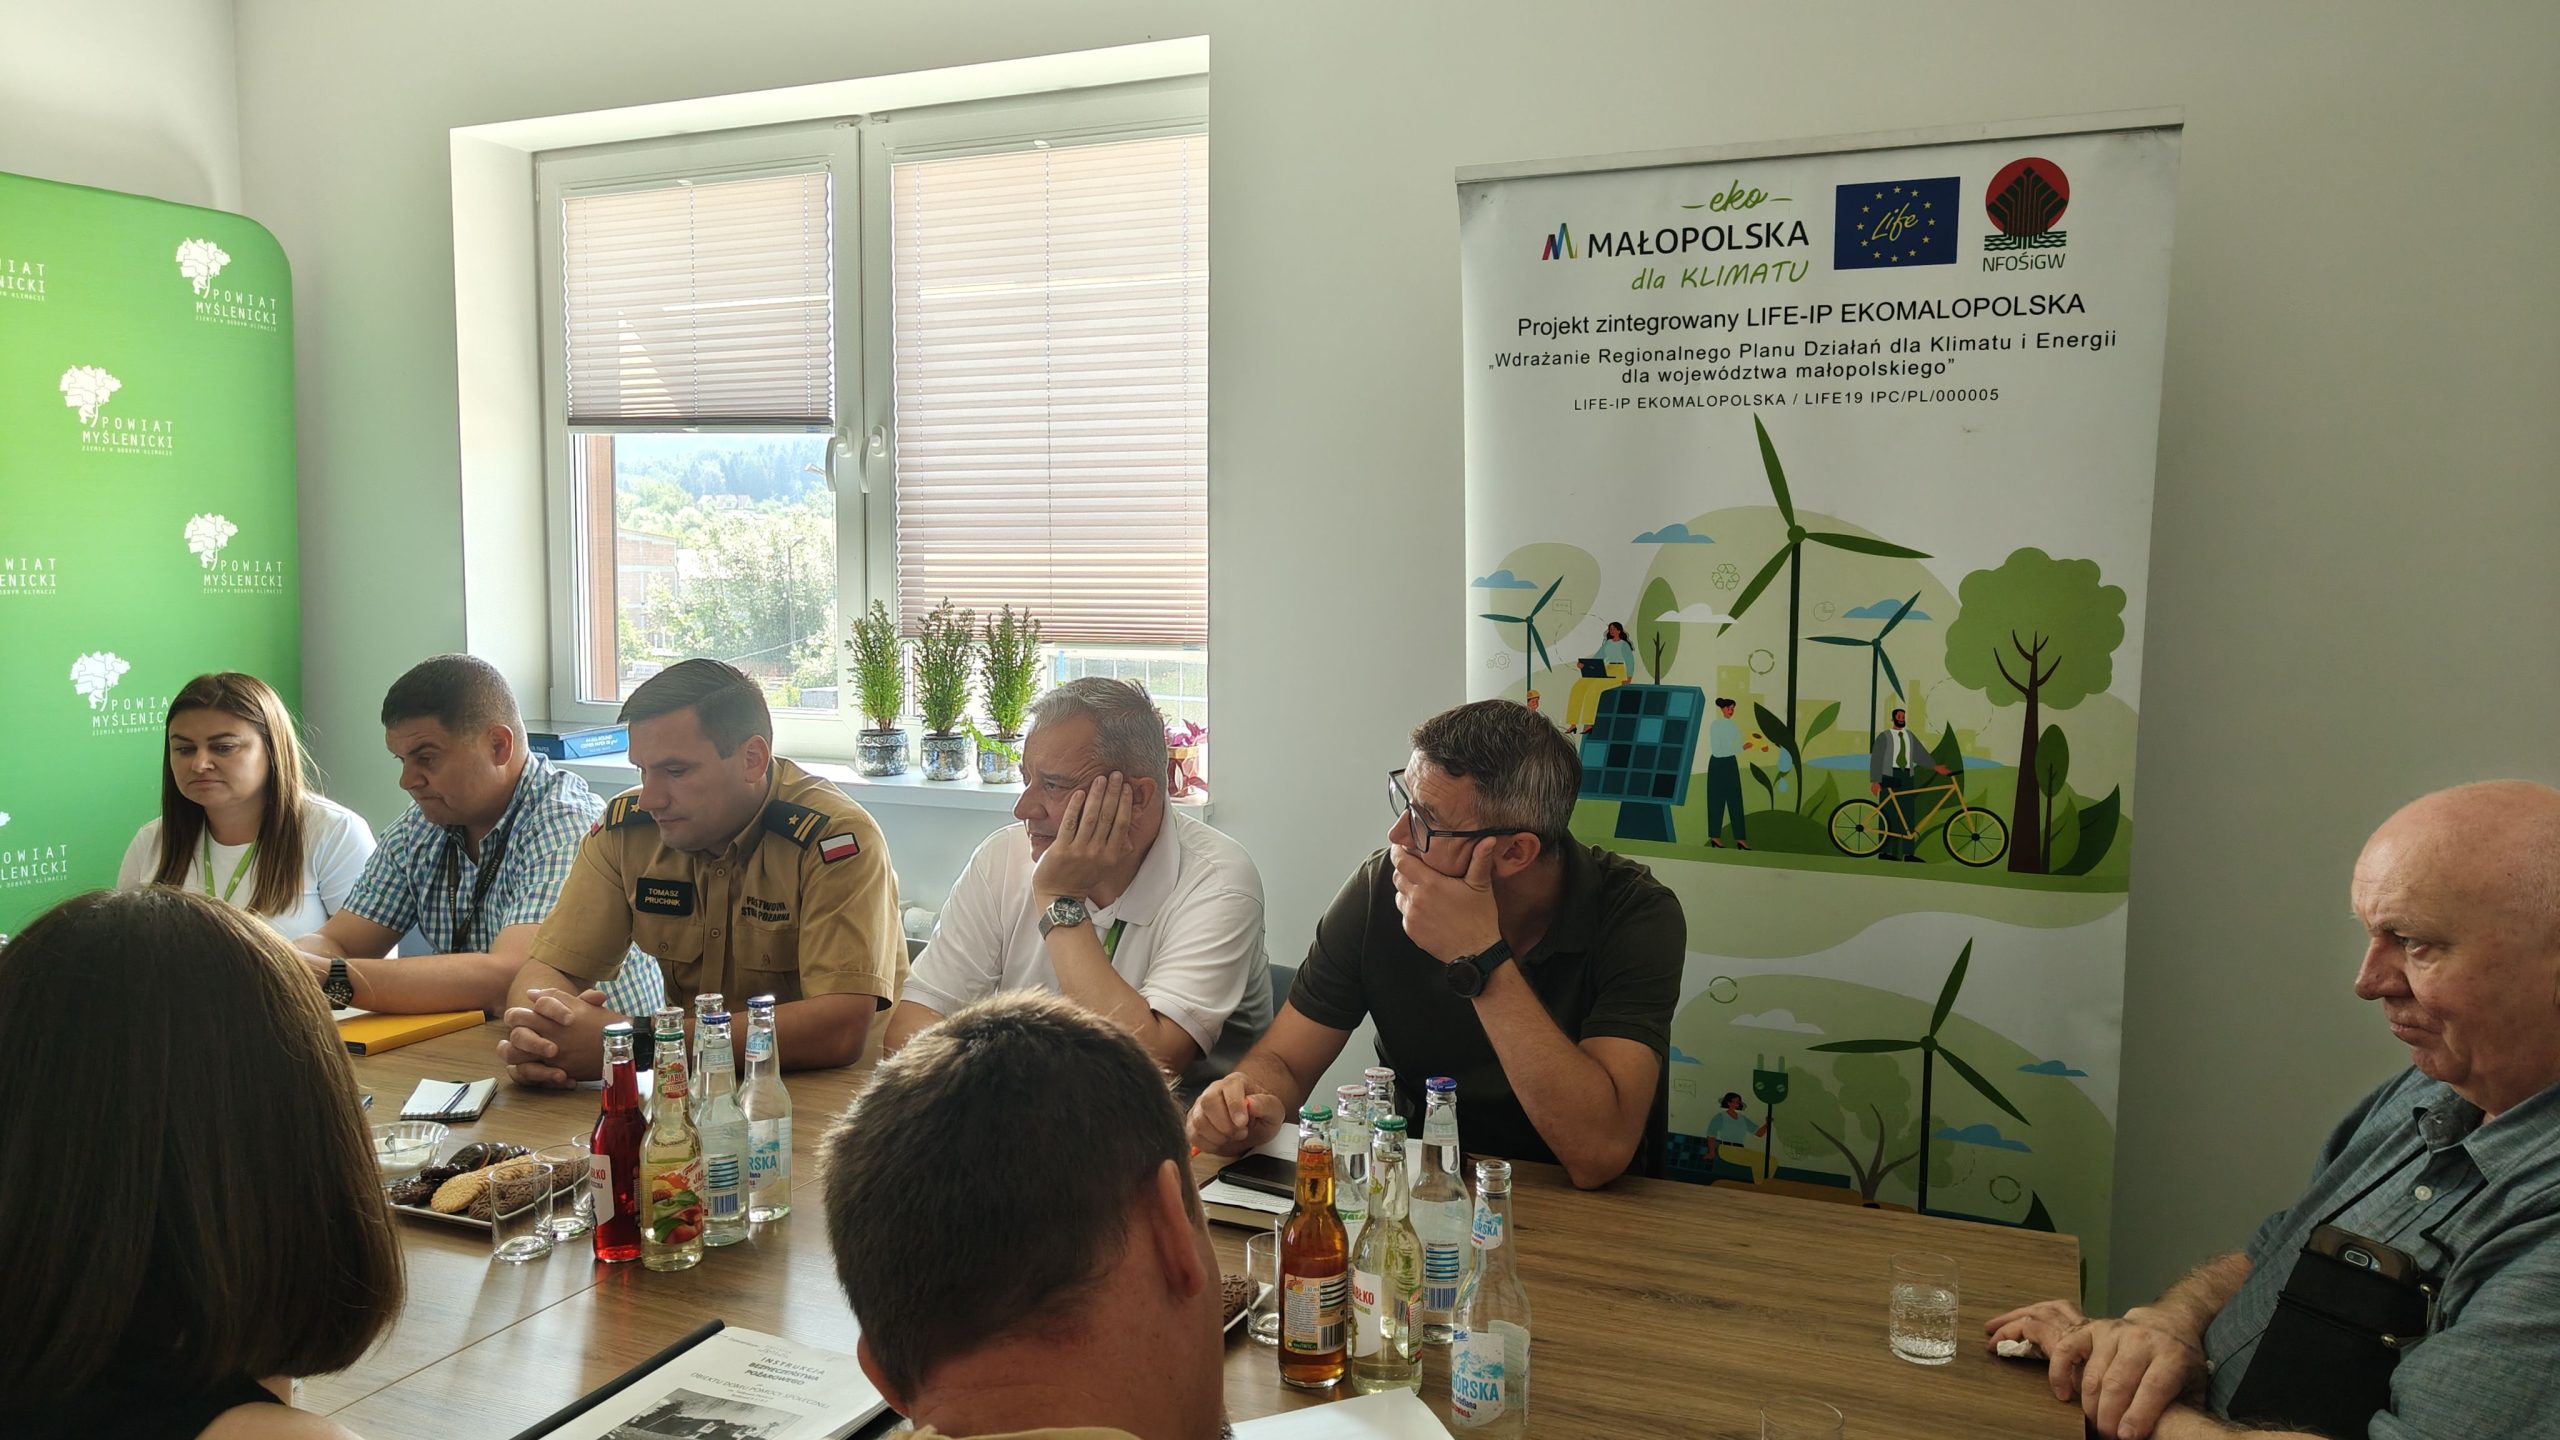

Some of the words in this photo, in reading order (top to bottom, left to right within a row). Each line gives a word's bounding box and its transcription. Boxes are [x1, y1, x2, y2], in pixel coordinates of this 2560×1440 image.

[1709, 179, 1768, 212] eko
[1872, 202, 1919, 241] Life
[1588, 220, 1809, 258] MAŁOPOLSKA
[0, 258, 45, 277] IAT
[1631, 268, 1665, 290] dla
[1680, 260, 1809, 288] KLIMATU
[213, 288, 277, 310] POWIAT
[196, 301, 277, 325] MYŚLENICKI
[1518, 315, 1590, 340] Projekt
[1596, 312, 1740, 336] zintegrowany
[1747, 304, 1833, 327] LIFE-IP
[1841, 293, 2086, 323] EKOMALOPOLSKA
[1599, 345, 1731, 366] Regionalnego
[1739, 343, 1796, 358] Planu
[1804, 338, 1881, 356] Działań
[1890, 337, 1921, 353] dla
[1930, 334, 2011, 352] Klimatu
[2021, 333, 2026, 349] i
[2036, 330, 2117, 351] Energii
[1622, 369, 1650, 383] dla
[1658, 366, 1787, 385] województwa
[1574, 398, 1631, 411] LIFE-IP
[1637, 393, 1786, 409] EKOMALOPOLSKA
[1792, 393, 1798, 405] /
[1805, 391, 1863, 405] LIFE19
[1870, 388, 1999, 404] IPC/PL/000005
[102, 416, 173, 433] POWIAT
[82, 430, 172, 448] MYŚLENICKI
[220, 559, 282, 572] POWIAT
[203, 572, 282, 587] MYŚLENICKI
[111, 696, 168, 711] POWIA
[92, 712, 168, 728] MYŚLENIC
[648, 887, 679, 898] TOMASZ
